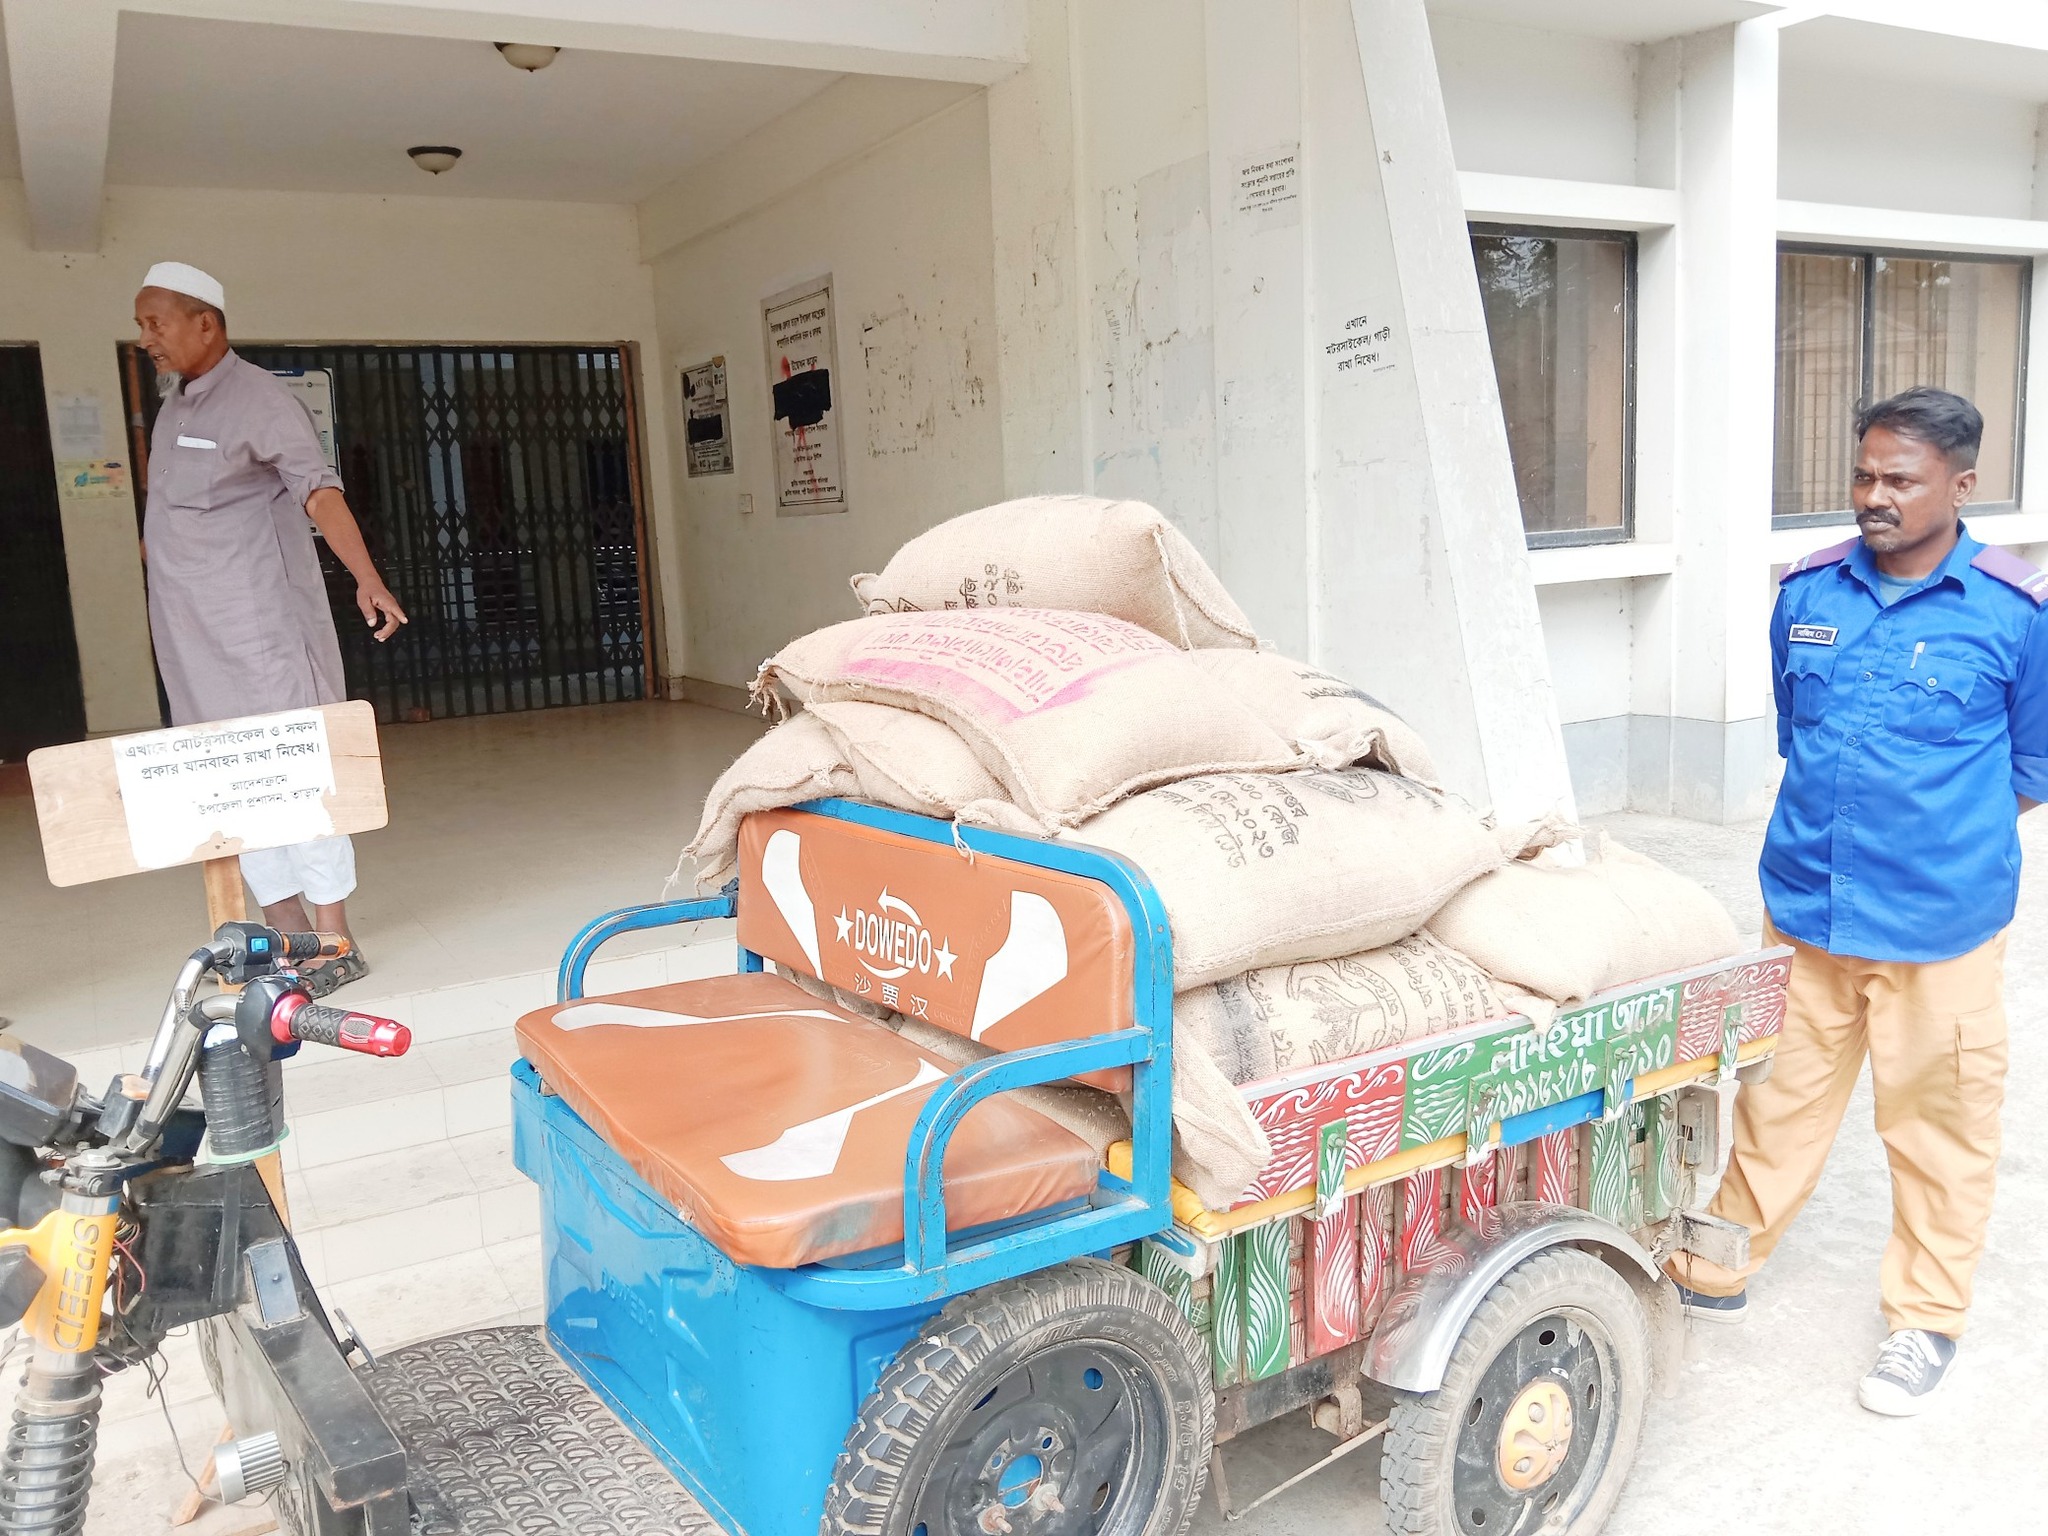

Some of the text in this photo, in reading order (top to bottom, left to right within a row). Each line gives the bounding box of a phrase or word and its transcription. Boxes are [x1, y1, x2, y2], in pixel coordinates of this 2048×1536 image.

[1344, 315, 1368, 330] এখানে
[1373, 326, 1391, 342] গাড়ী
[1337, 358, 1353, 372] রাখা
[126, 720, 318, 759] এখানে মোটরসাইকেল ও সকল
[141, 763, 179, 780] প্রকার
[185, 754, 240, 772] যানবাহন
[245, 749, 272, 764] রাখা
[198, 798, 242, 815] উপজেলা
[853, 908, 933, 975] DOWEDO
[853, 971, 930, 1021] 沙贾汉
[54, 1218, 100, 1350] SPEED
